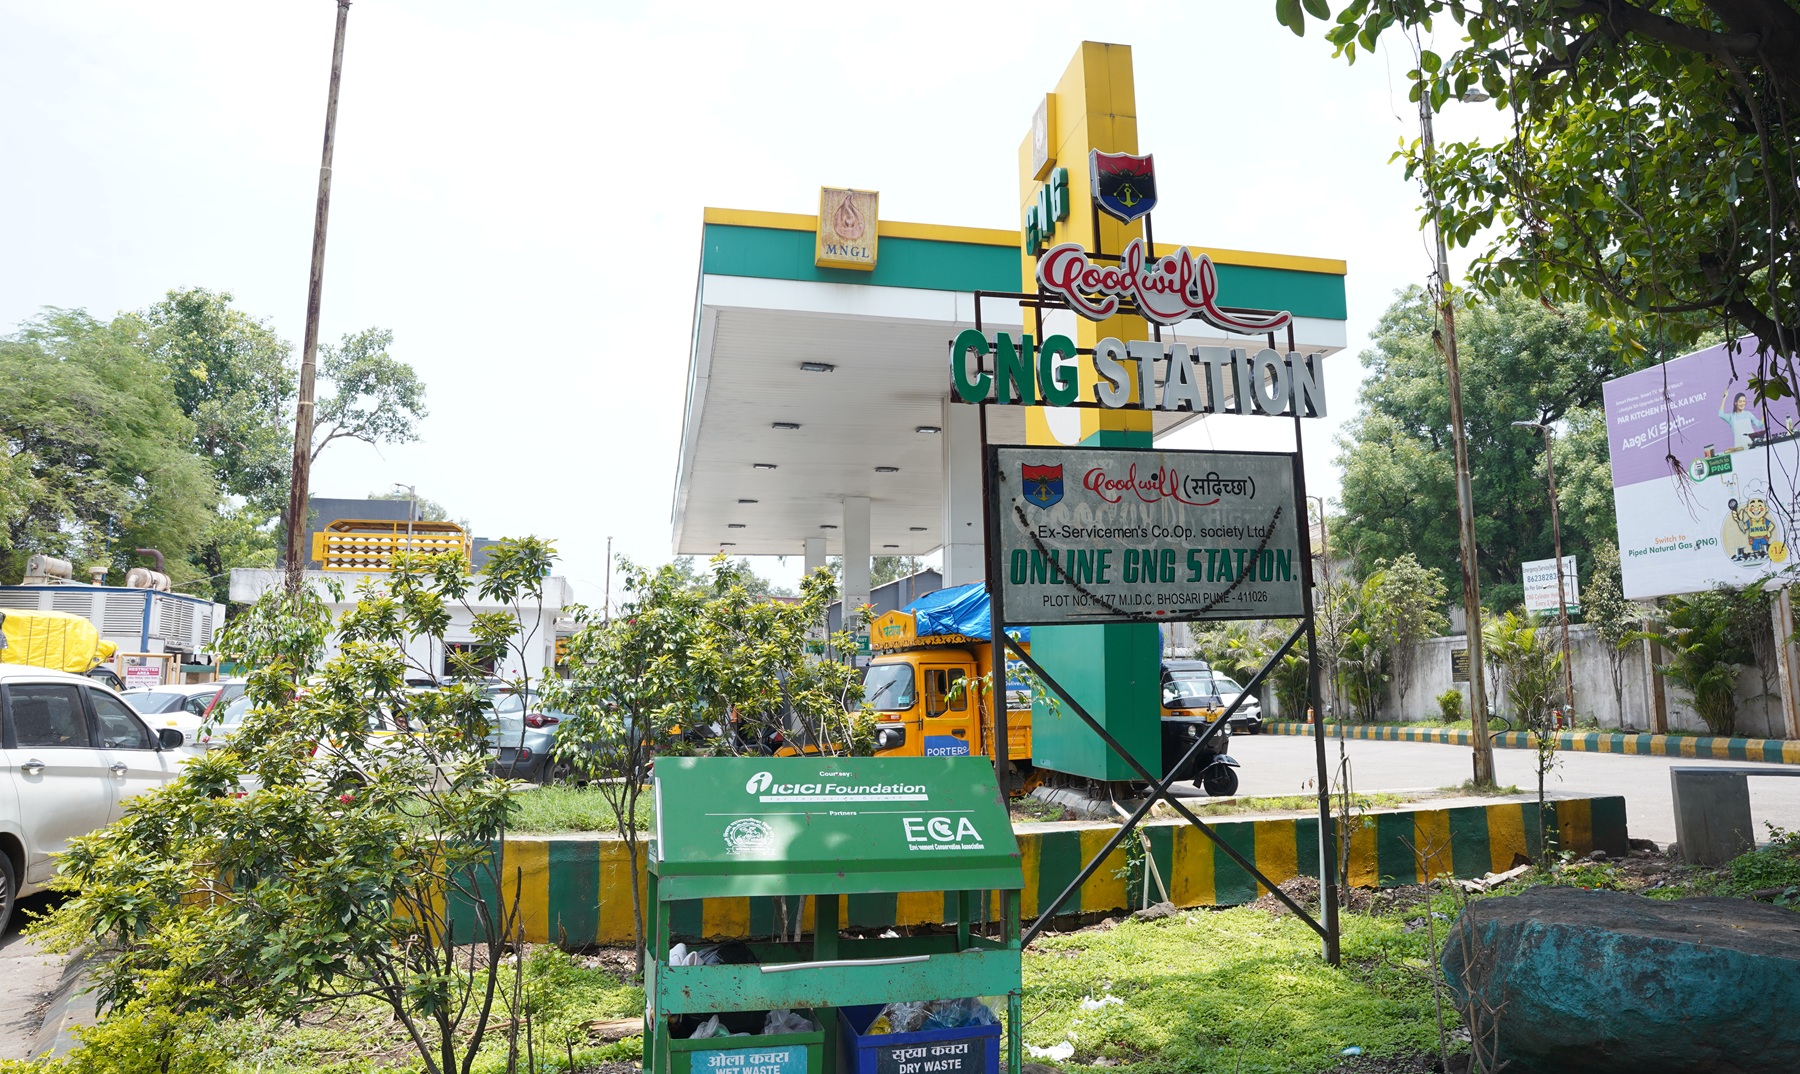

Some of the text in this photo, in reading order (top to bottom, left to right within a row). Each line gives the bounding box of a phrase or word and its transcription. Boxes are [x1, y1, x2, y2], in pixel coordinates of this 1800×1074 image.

[1025, 167, 1070, 256] CNG
[826, 244, 869, 258] MNGL
[1039, 240, 1291, 332] Goodwill
[950, 329, 1327, 418] CNG STATION
[1617, 416, 1630, 424] PAR
[1630, 406, 1660, 420] KITCHEN
[1678, 398, 1689, 407] KA
[1689, 392, 1707, 404] KYA?
[1622, 432, 1647, 450] Aage
[1647, 425, 1659, 440] Ki
[1711, 463, 1730, 473] PNG
[1083, 463, 1220, 506] Goodwill
[1184, 471, 1255, 499] (सदिच्छा)
[1038, 525, 1148, 538] Ex-Servicemen's
[1151, 525, 1196, 540] Co.Op.
[1200, 525, 1244, 540] society
[1655, 534, 1686, 544] Switch to
[1628, 537, 1718, 557] Piped Natural Gas PNG)
[1010, 549, 1112, 585] ONLINE
[1123, 548, 1176, 584] CNG
[1526, 572, 1558, 583] 86238283
[1043, 595, 1069, 607] PLOT
[1119, 593, 1154, 606] M.I.D.C.
[1158, 593, 1200, 605] BHOSARI
[1203, 592, 1230, 604] PUNE
[1237, 591, 1268, 603] 411026
[927, 746, 963, 756] PORTER
[772, 784, 822, 795] ICICI
[825, 783, 926, 794] Foundation
[903, 816, 982, 841] ECA
[708, 1051, 790, 1067] ओला कचरा
[892, 1043, 968, 1063] सुखा कचरा
[742, 1065, 780, 1074] WASTE
[899, 1059, 962, 1074] DRY WASTE
